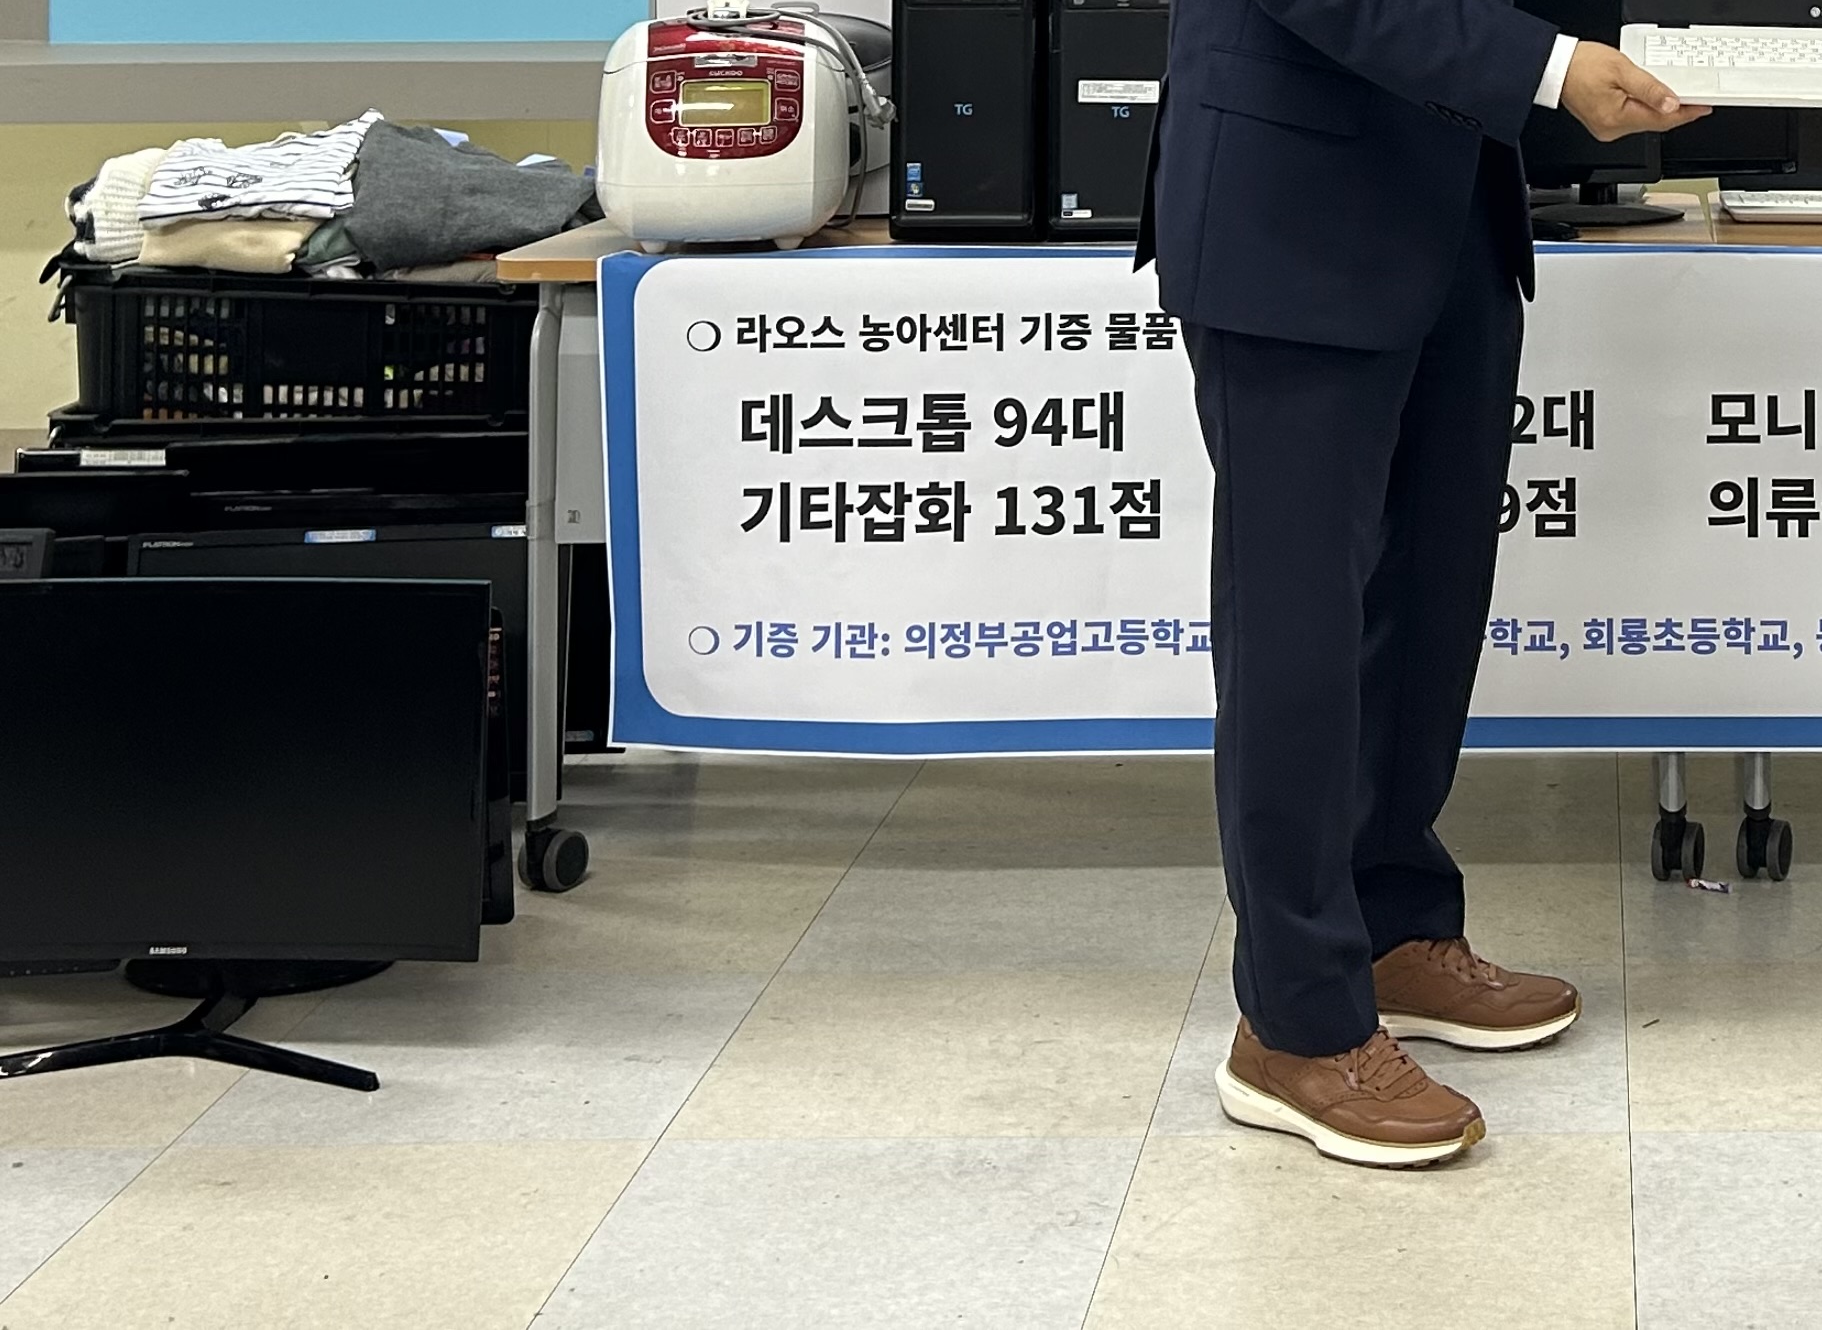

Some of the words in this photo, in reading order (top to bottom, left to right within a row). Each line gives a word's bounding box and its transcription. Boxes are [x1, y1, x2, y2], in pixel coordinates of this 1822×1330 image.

[954, 104, 973, 116] TG
[1111, 106, 1130, 118] TG
[737, 314, 845, 354] 라오스
[859, 313, 1005, 353] 농아센터
[1020, 313, 1092, 352] 기증
[1105, 313, 1178, 350] 물품
[741, 392, 972, 455] 데스크톱
[993, 391, 1124, 452] 94대
[740, 480, 972, 544] 기타잡화
[994, 478, 1162, 540] 131점
[732, 621, 799, 659] 기증
[811, 621, 890, 660] 기관:
[904, 618, 1212, 659] 의정부공업고등학교
[1485, 618, 1570, 660] 학교,
[1583, 617, 1804, 660] 회룡초등학교,
